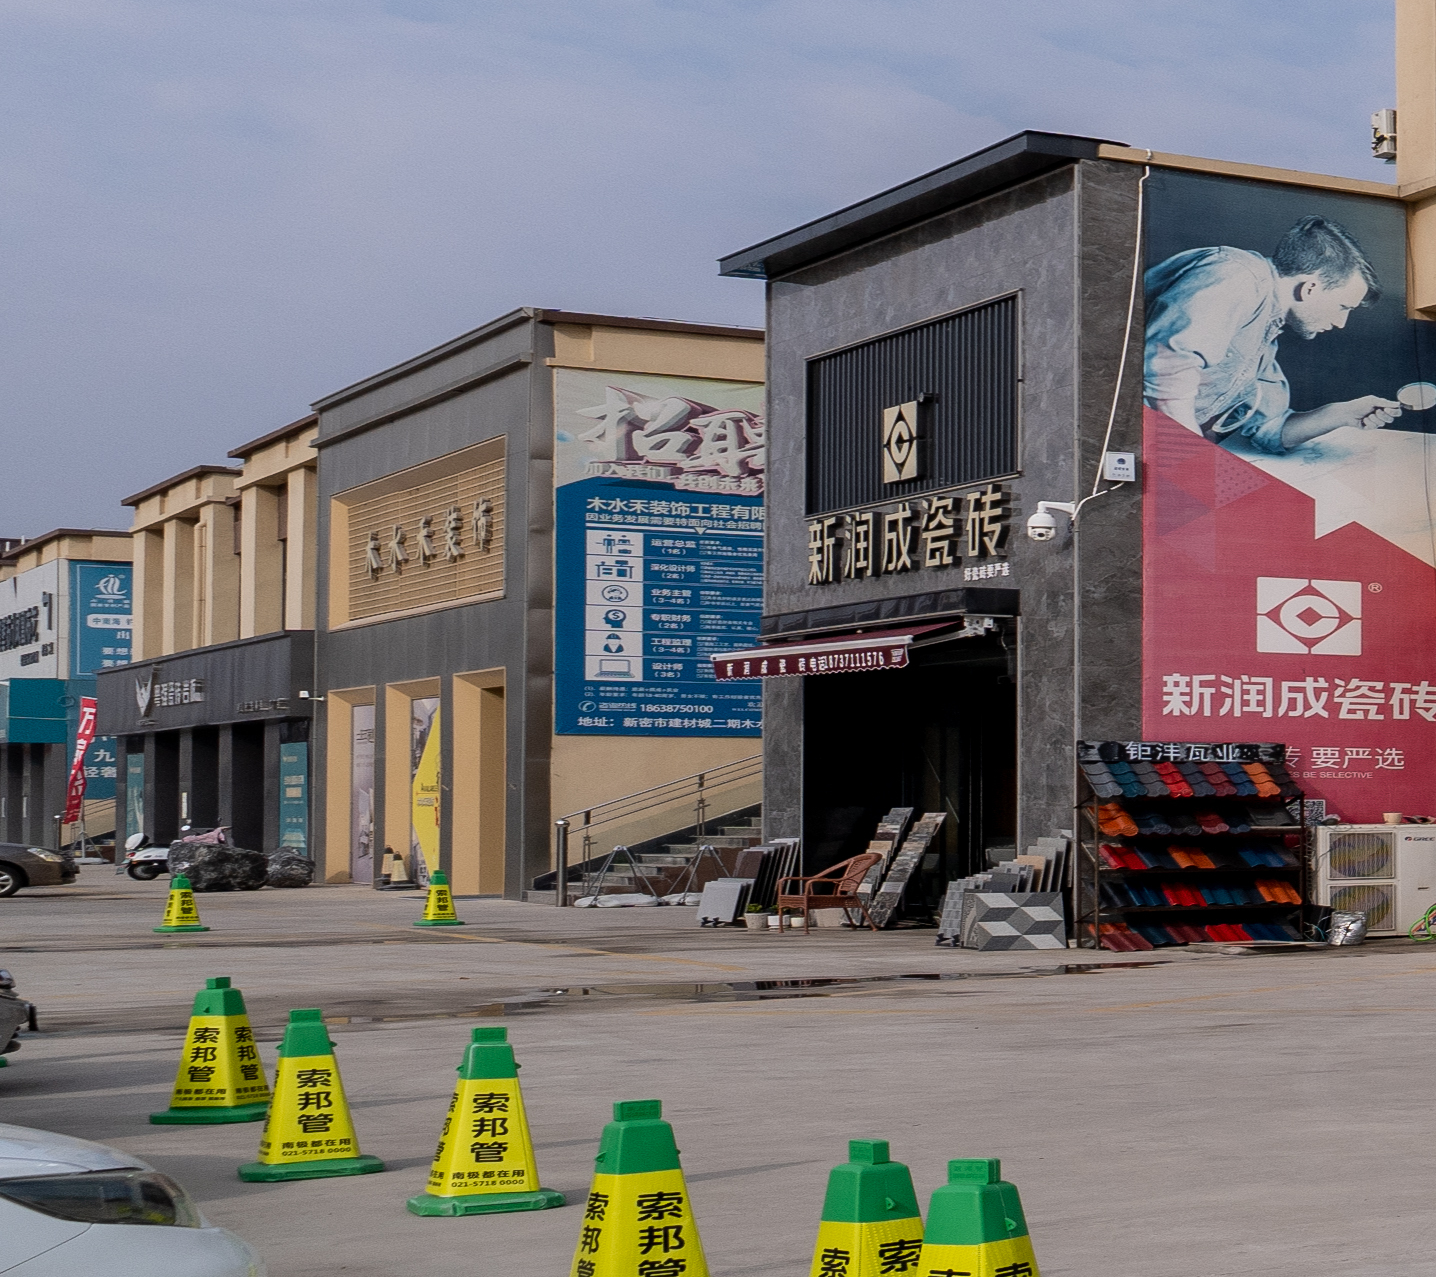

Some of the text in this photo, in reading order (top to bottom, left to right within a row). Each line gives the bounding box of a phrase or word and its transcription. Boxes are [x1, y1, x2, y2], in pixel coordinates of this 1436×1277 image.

[585, 512, 765, 531] 因业务发展需要特面向社会招聘
[809, 484, 1002, 585] 新润成瓷砖
[187, 1026, 220, 1083] 索邦管
[234, 1026, 260, 1081] 索邦管
[296, 1068, 333, 1134] 索邦管
[470, 1092, 510, 1163] 索邦管
[281, 1138, 351, 1149] 南极都在用
[451, 1169, 526, 1181] 南极都在用
